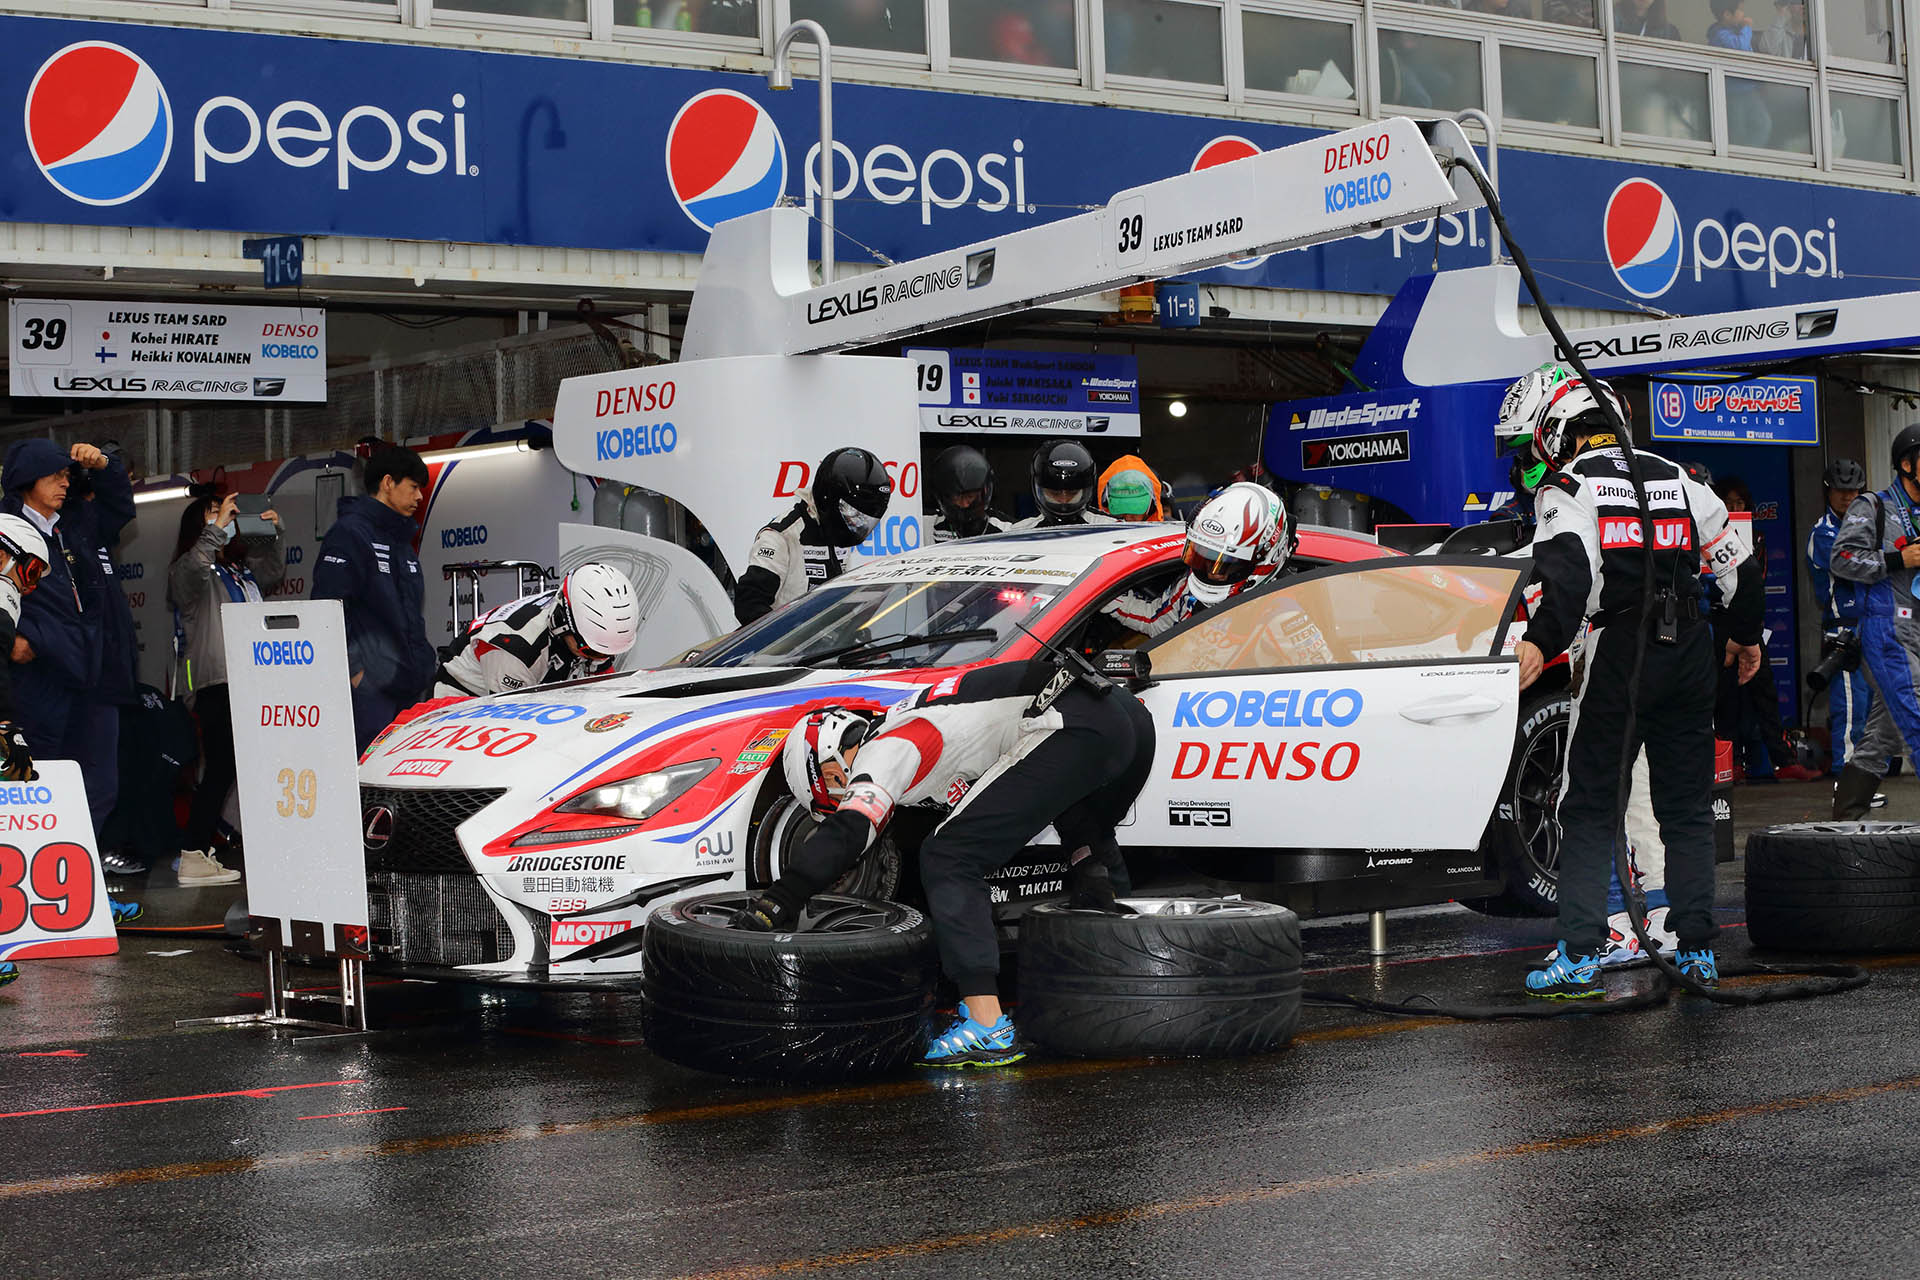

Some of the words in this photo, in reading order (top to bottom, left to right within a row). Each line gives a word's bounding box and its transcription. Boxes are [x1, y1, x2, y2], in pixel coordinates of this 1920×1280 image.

[194, 93, 467, 190] pepsi
[1324, 134, 1390, 174] DENSO
[805, 139, 1027, 225] pepsi
[1324, 171, 1391, 214] KOBELCO
[1118, 214, 1143, 254] 39
[1153, 230, 1184, 252] LEXUS
[1186, 225, 1213, 247] TEAM
[1216, 216, 1243, 242] SARD
[1693, 217, 1838, 288] pepsi
[808, 286, 878, 325] LEXUS
[881, 265, 962, 306] RACING
[1168, 295, 1196, 318] 11-B
[108, 311, 150, 325] LEXUS
[153, 312, 189, 326] TEAM
[191, 313, 228, 327] SARD
[22, 318, 67, 350] 39
[131, 331, 168, 345] Kohei
[171, 332, 220, 346] HIRATE
[262, 323, 319, 339] DENSO
[1553, 334, 1662, 363] LEXUS
[1667, 320, 1790, 349] RACING
[131, 349, 173, 364] Heikki
[176, 351, 251, 365] KOVALAINEN
[262, 343, 319, 360] KOBELCO
[54, 376, 147, 393] LEXUS
[151, 379, 249, 394] RACING
[917, 364, 943, 392] 19
[595, 381, 676, 418] DENSO
[1662, 391, 1681, 418] 18
[1693, 384, 1724, 412] UP
[1725, 384, 1802, 413] GARAGE
[937, 414, 1007, 428] LEXUS
[1010, 417, 1083, 429] RACING
[1307, 398, 1421, 429] WedsSport
[1717, 415, 1785, 426] RACING
[597, 422, 677, 461] KOBELCO
[1328, 438, 1404, 461] YOKOHAMA
[441, 525, 488, 549] KOBELCO
[1202, 519, 1225, 535] Arai
[253, 640, 314, 666] KOBELCO
[502, 676, 524, 689] OMP
[260, 705, 320, 727] DENSO
[429, 703, 588, 725] KOBELCO
[1172, 688, 1363, 728] KOBELCO
[384, 725, 538, 758] DENSO
[393, 760, 450, 775] MOTUL
[808, 752, 823, 794] ATOMIC
[1171, 741, 1360, 782] DENSO
[276, 767, 318, 819] 39
[1168, 800, 1189, 808] Racing
[1190, 800, 1231, 808] Development
[1170, 810, 1228, 827] TRD
[505, 855, 627, 872] BRIDGESTONE
[721, 857, 735, 865] AW
[1375, 857, 1414, 866] ATOMIC
[522, 877, 615, 893] 豊田自動織機
[1019, 880, 1063, 896] TAKATA
[548, 897, 588, 912] BBS
